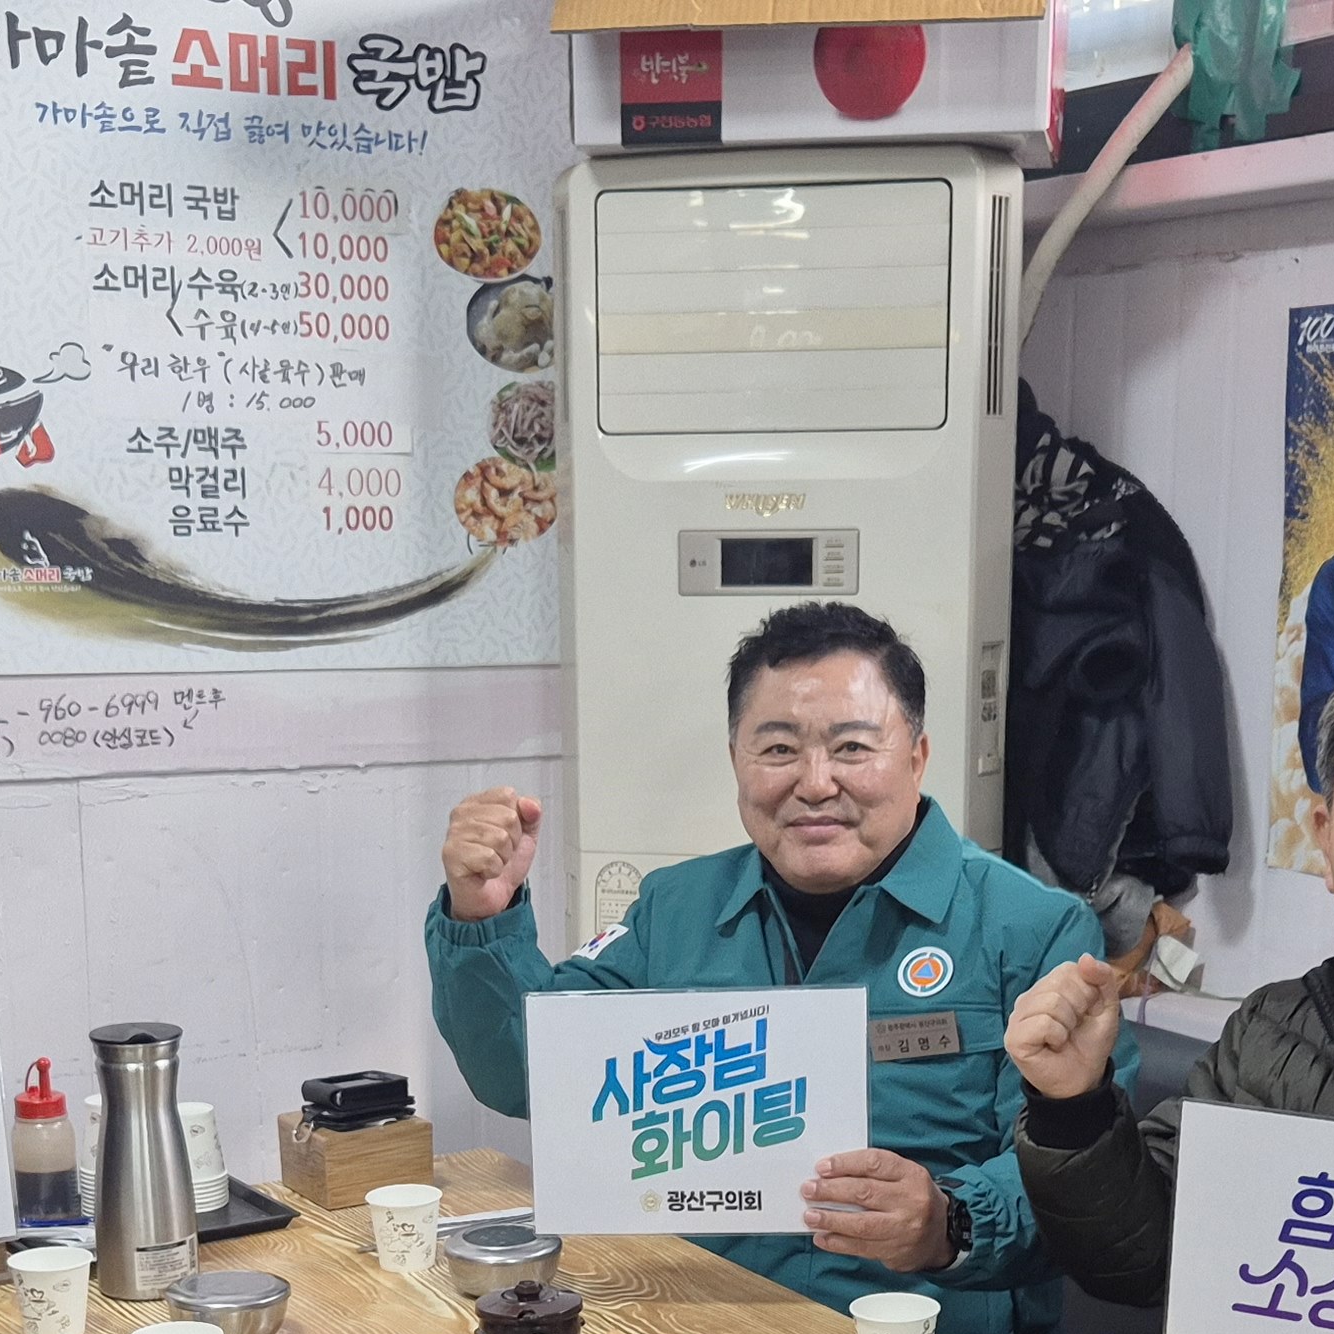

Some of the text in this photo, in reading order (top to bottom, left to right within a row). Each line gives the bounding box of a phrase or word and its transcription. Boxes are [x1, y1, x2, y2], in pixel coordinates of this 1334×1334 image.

[171, 27, 337, 101] 소머리
[347, 33, 487, 113] 국밥
[34, 100, 429, 156] 가마솥으로 직접 끓여 맛있습니다!
[88, 179, 393, 223] 소머리 국밥 10,000
[86, 225, 263, 262] 고기추가 2,000원
[298, 231, 389, 264] 10,000
[92, 263, 176, 299] 소머리
[187, 266, 241, 303] 수육
[298, 271, 390, 304] 30,000
[186, 308, 238, 346] 수육
[298, 310, 390, 343] 50,000
[329, 362, 366, 388] 판매
[126, 420, 394, 460] 소주/맥주 5,000
[169, 466, 402, 500] 막걸리 4,000
[168, 505, 394, 537] 음료수 1,000
[24, 567, 60, 582] 소머리
[38, 727, 87, 748] 0080
[591, 1016, 769, 1123] 사장님
[630, 1075, 809, 1180] 화이팅
[667, 1189, 763, 1212] 광산구의회
